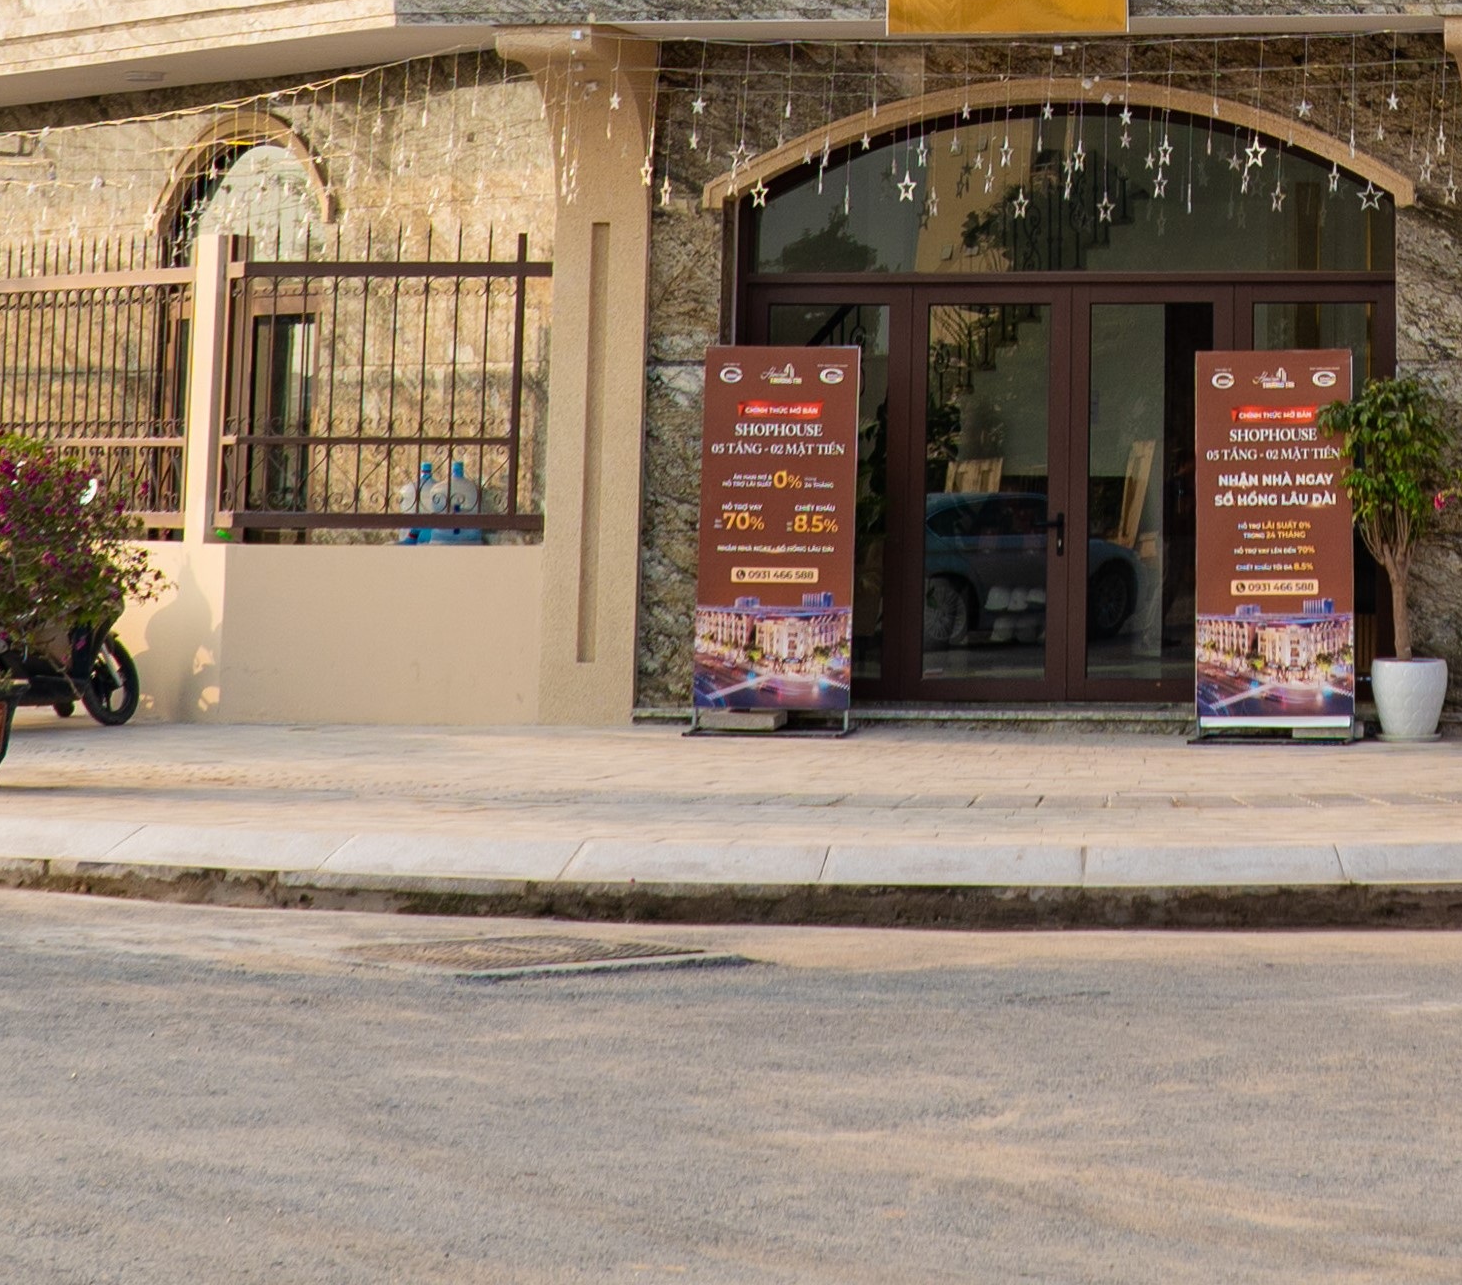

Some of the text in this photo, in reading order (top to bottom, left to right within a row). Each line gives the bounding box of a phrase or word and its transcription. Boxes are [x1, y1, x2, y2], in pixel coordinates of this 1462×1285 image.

[735, 423, 823, 437] SHOPHOUSE
[1230, 428, 1317, 442] SHOPHOUSE
[711, 443, 724, 454] 05
[770, 443, 783, 454] 02
[1206, 450, 1219, 461] 05
[1266, 449, 1278, 460] 02
[773, 470, 802, 489] 0%
[1218, 471, 1333, 489] NHẬN NHÀ NGAY
[1281, 490, 1308, 505] LÂU
[1311, 490, 1336, 505] DÀI
[723, 512, 765, 530] 70%
[794, 513, 838, 533] 8.5%
[1278, 530, 1306, 539] THÁNG
[1294, 562, 1313, 571] 8.5%
[748, 570, 813, 579] 0931 466 588
[1248, 583, 1314, 591] 0931 466 588
